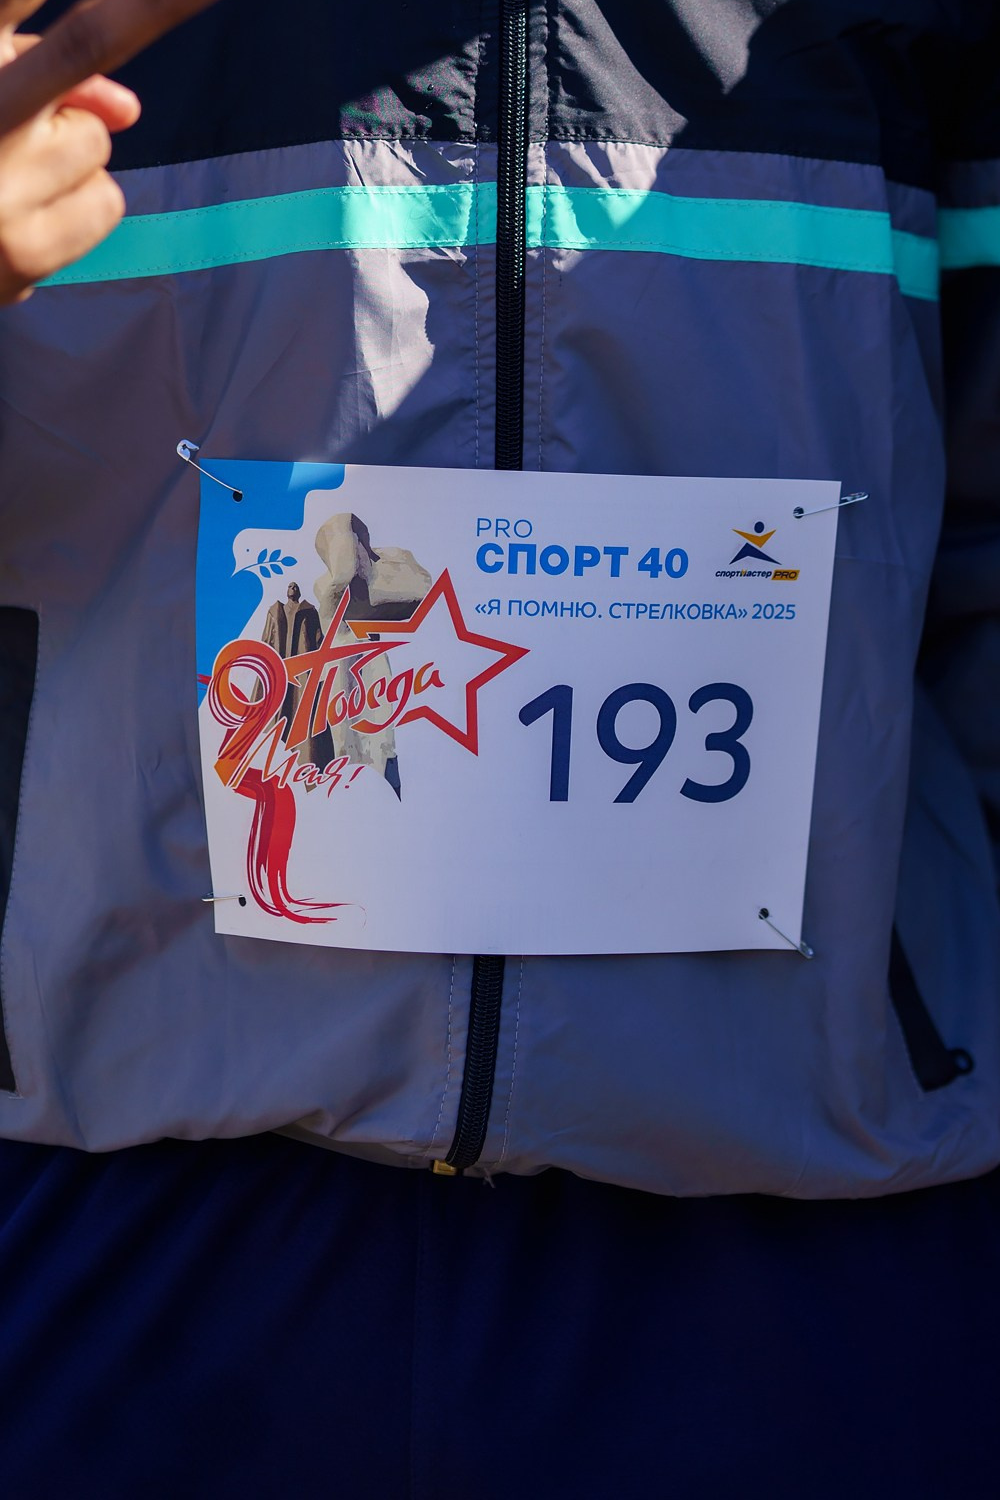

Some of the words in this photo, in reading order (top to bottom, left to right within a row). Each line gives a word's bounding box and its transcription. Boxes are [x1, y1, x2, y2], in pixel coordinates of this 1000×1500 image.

[476, 517, 533, 539] PRO
[475, 542, 630, 578] СПОРТ
[637, 547, 689, 579] 40
[773, 570, 798, 580] PRO
[474, 598, 501, 616] «Я
[508, 599, 603, 619] ПОМНЮ.
[608, 602, 748, 621] СТРЕЛКОВКА»
[751, 603, 796, 621] 2025
[518, 682, 754, 804] 193
